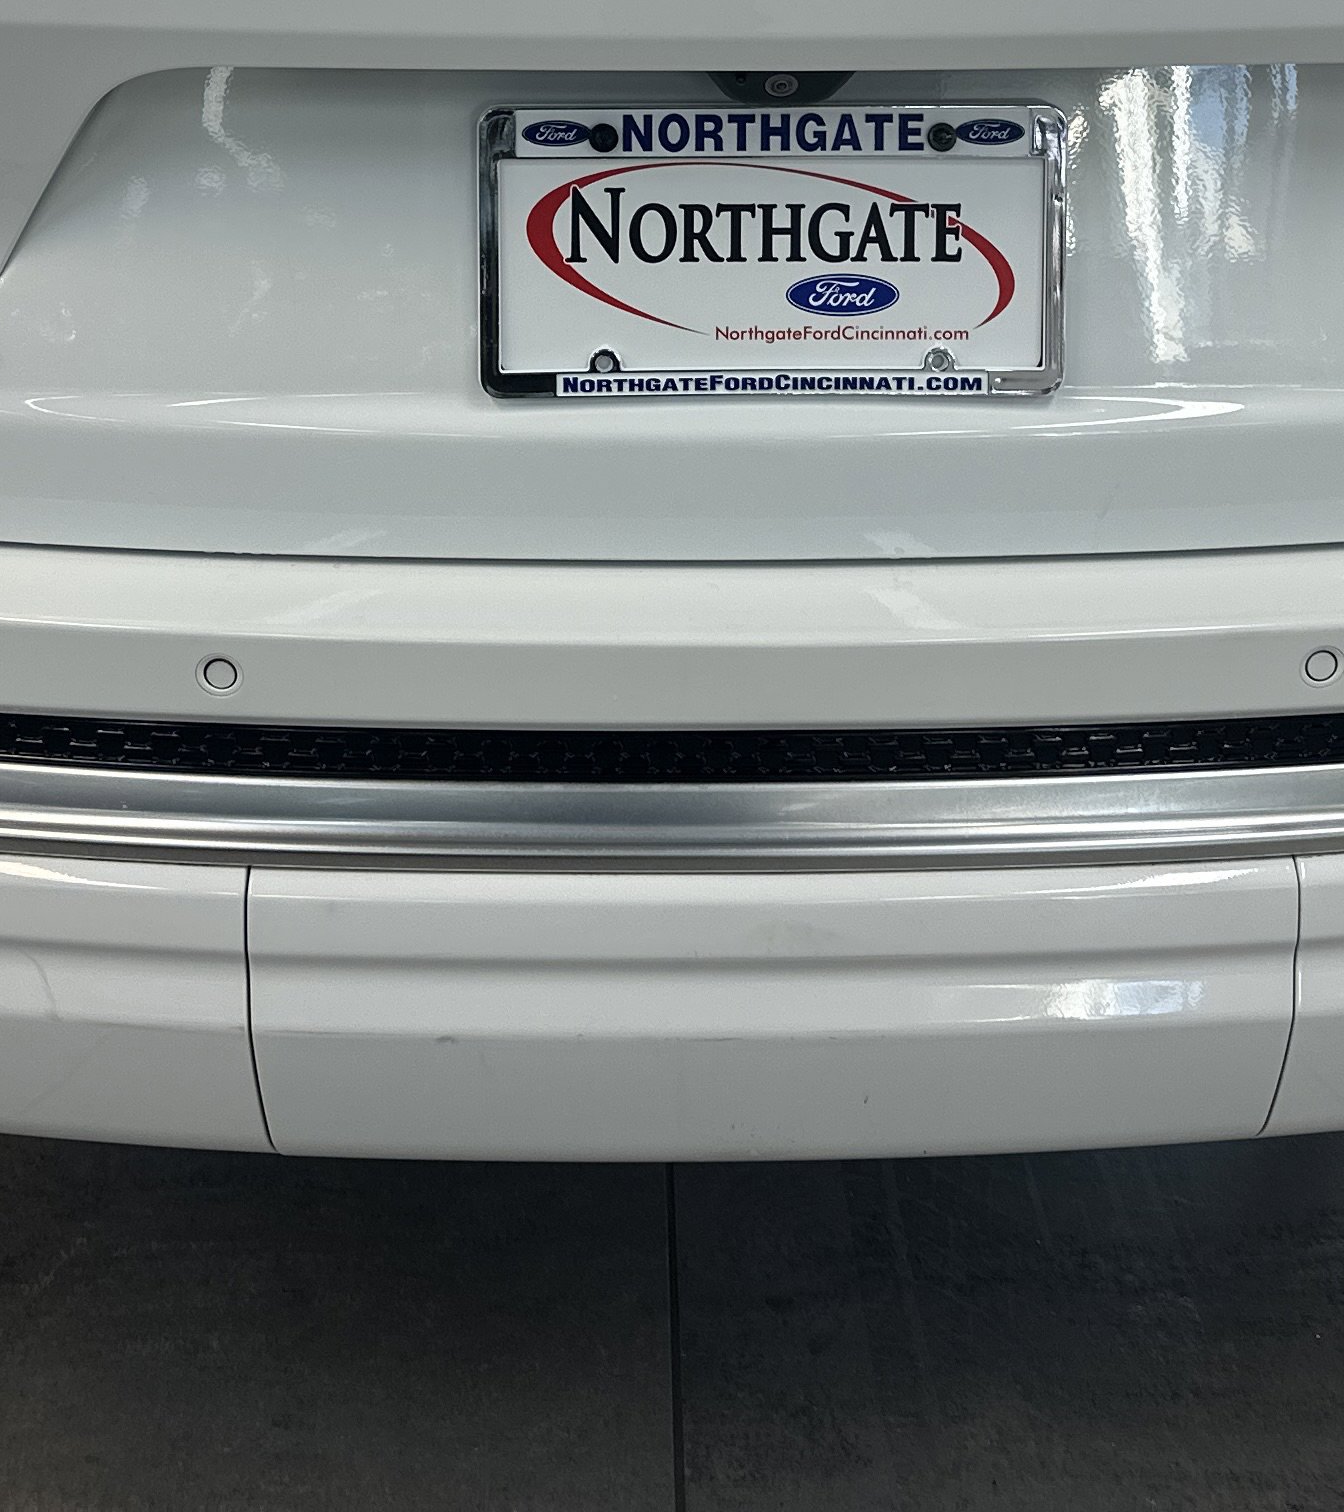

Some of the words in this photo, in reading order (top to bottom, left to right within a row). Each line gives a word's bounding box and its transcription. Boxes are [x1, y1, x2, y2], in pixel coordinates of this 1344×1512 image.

[535, 124, 578, 141] Ford
[622, 113, 924, 153] NORTHGATE
[968, 123, 1011, 140] Ford
[564, 185, 963, 264] NORTHGATE
[808, 279, 876, 308] Ford
[714, 325, 970, 344] NorthgateFordCincinnati.com
